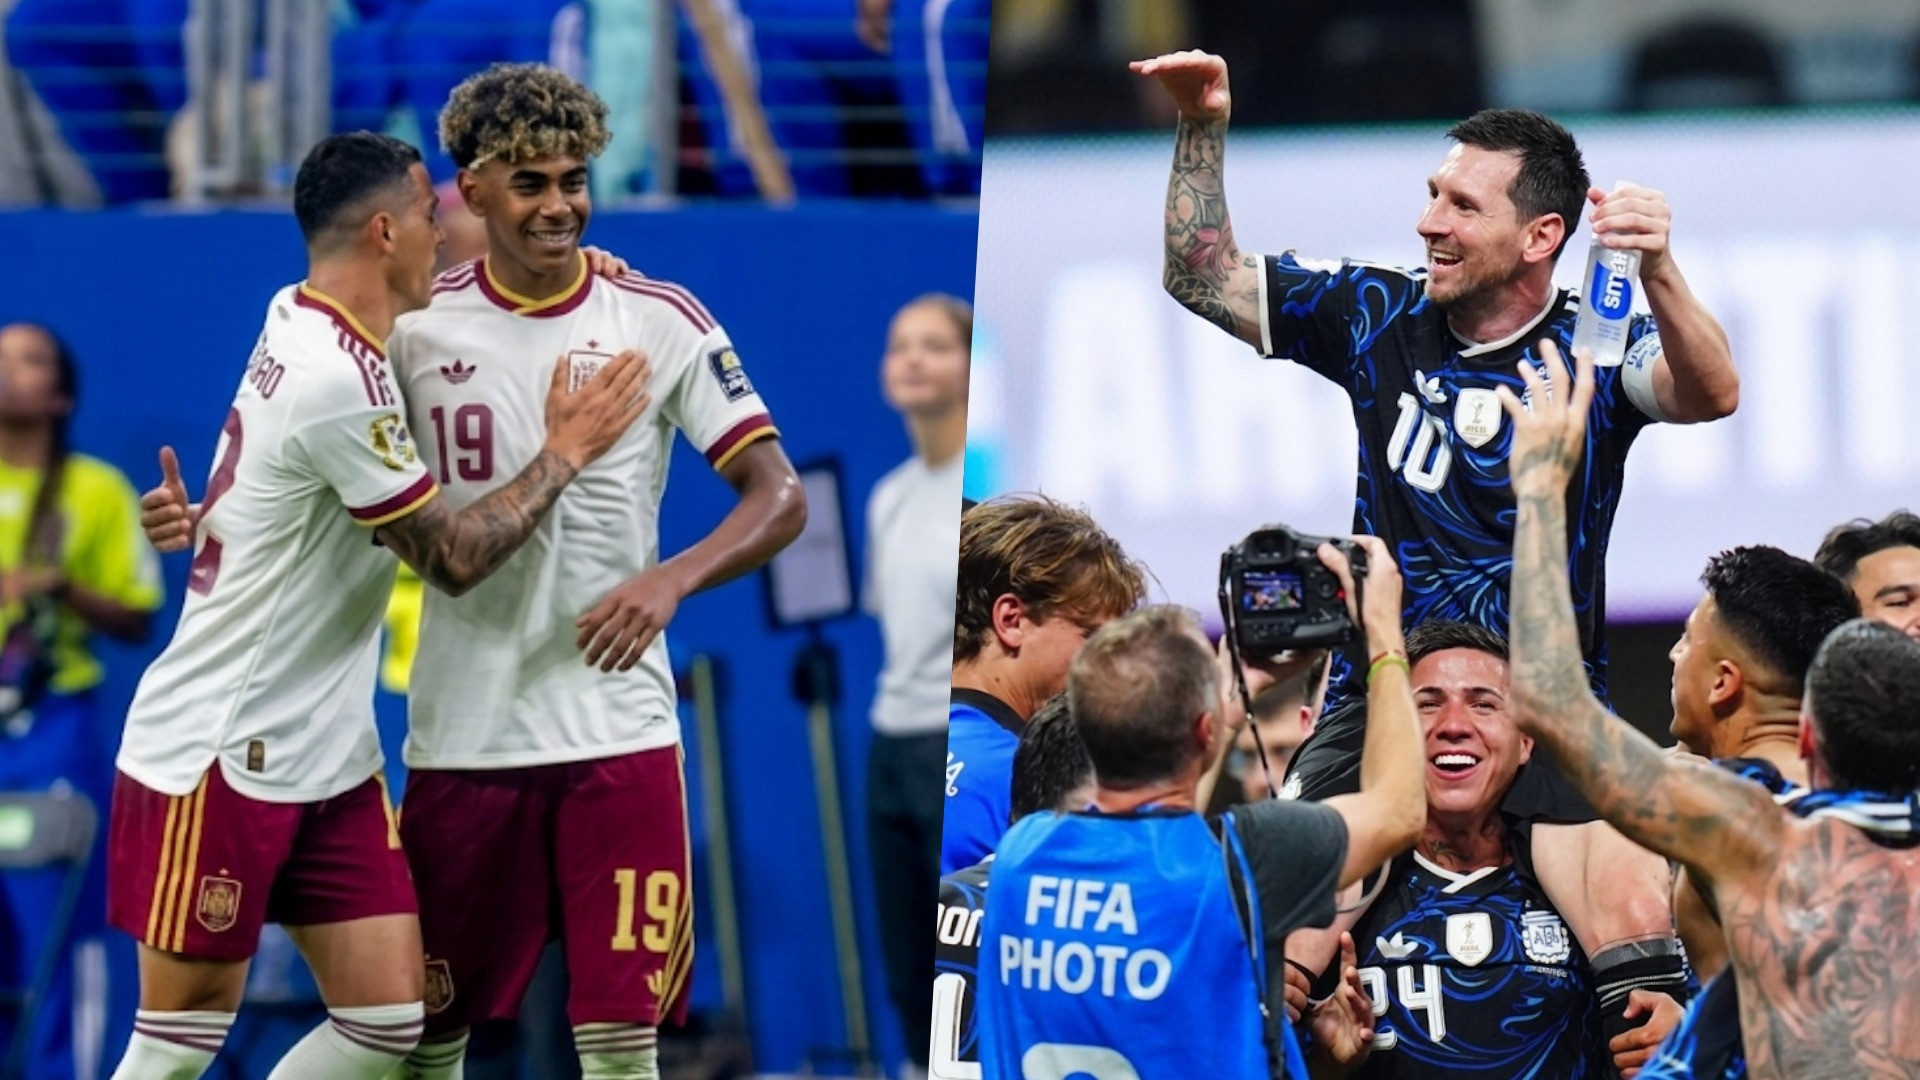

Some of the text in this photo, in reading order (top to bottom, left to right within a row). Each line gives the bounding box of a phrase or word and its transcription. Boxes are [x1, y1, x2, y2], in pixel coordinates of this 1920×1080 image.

[430, 403, 494, 485] 19
[1387, 391, 1453, 494] 10
[611, 868, 680, 952] 19
[1025, 874, 1139, 936] FIFA
[1000, 934, 1172, 1001] PHOTO
[1357, 963, 1447, 1050] 24
